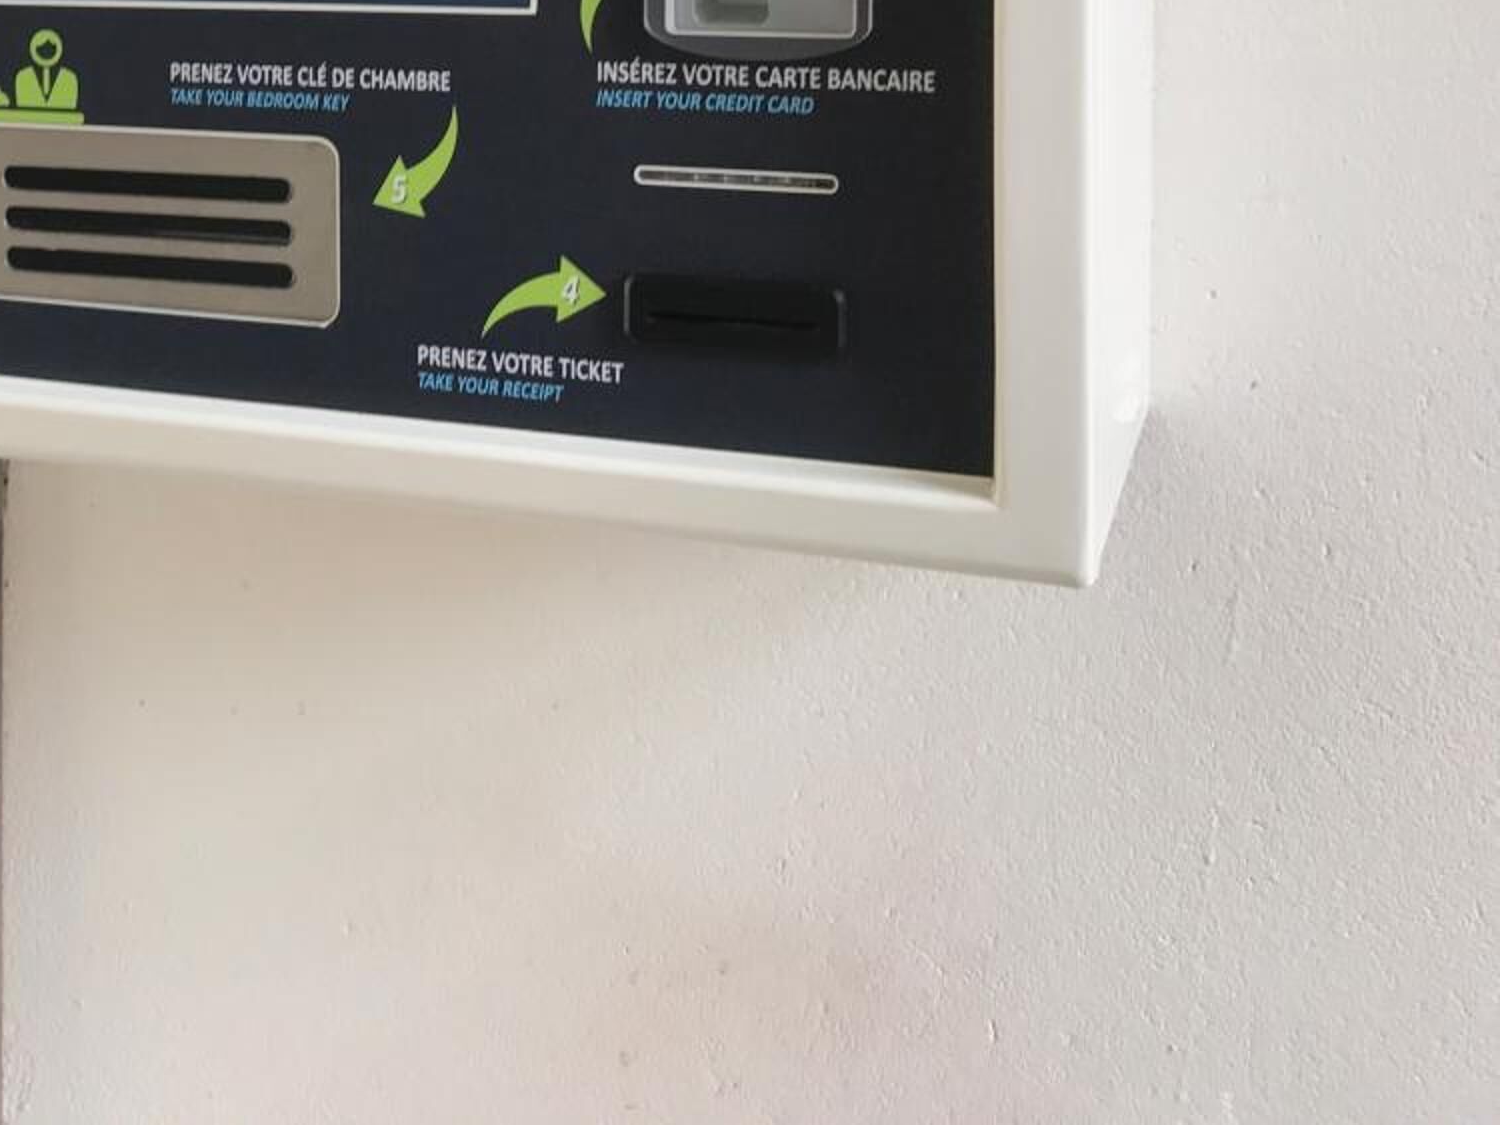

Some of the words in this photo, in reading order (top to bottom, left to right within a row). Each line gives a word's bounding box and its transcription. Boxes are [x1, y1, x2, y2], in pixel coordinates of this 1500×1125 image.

[170, 62, 233, 84] PRENEZ
[236, 64, 293, 87] VOTRE
[297, 61, 328, 87] CLÉ
[332, 67, 355, 88] DE
[359, 69, 451, 92] CHAMBRE
[597, 56, 677, 85] INSÉREZ
[682, 63, 750, 87] VOTRE
[755, 66, 821, 90] CARTE
[828, 68, 936, 93] BANCAIRE
[170, 88, 202, 107] TAKE
[205, 89, 243, 108] YOUR
[247, 91, 320, 110] BEDROOM
[322, 93, 351, 112] KEY
[596, 90, 652, 109] INSERT
[656, 91, 700, 111] YOUR
[705, 92, 763, 113] CREDIT
[767, 94, 815, 115] CARD
[392, 175, 406, 204] 5
[562, 276, 581, 305] 4
[417, 344, 487, 371] PRENEZ
[491, 350, 554, 377] VOTRE
[558, 357, 625, 384] TICKET
[418, 372, 453, 392] TAKE
[457, 375, 499, 396] YOUR
[503, 380, 565, 402] RECEIPT
